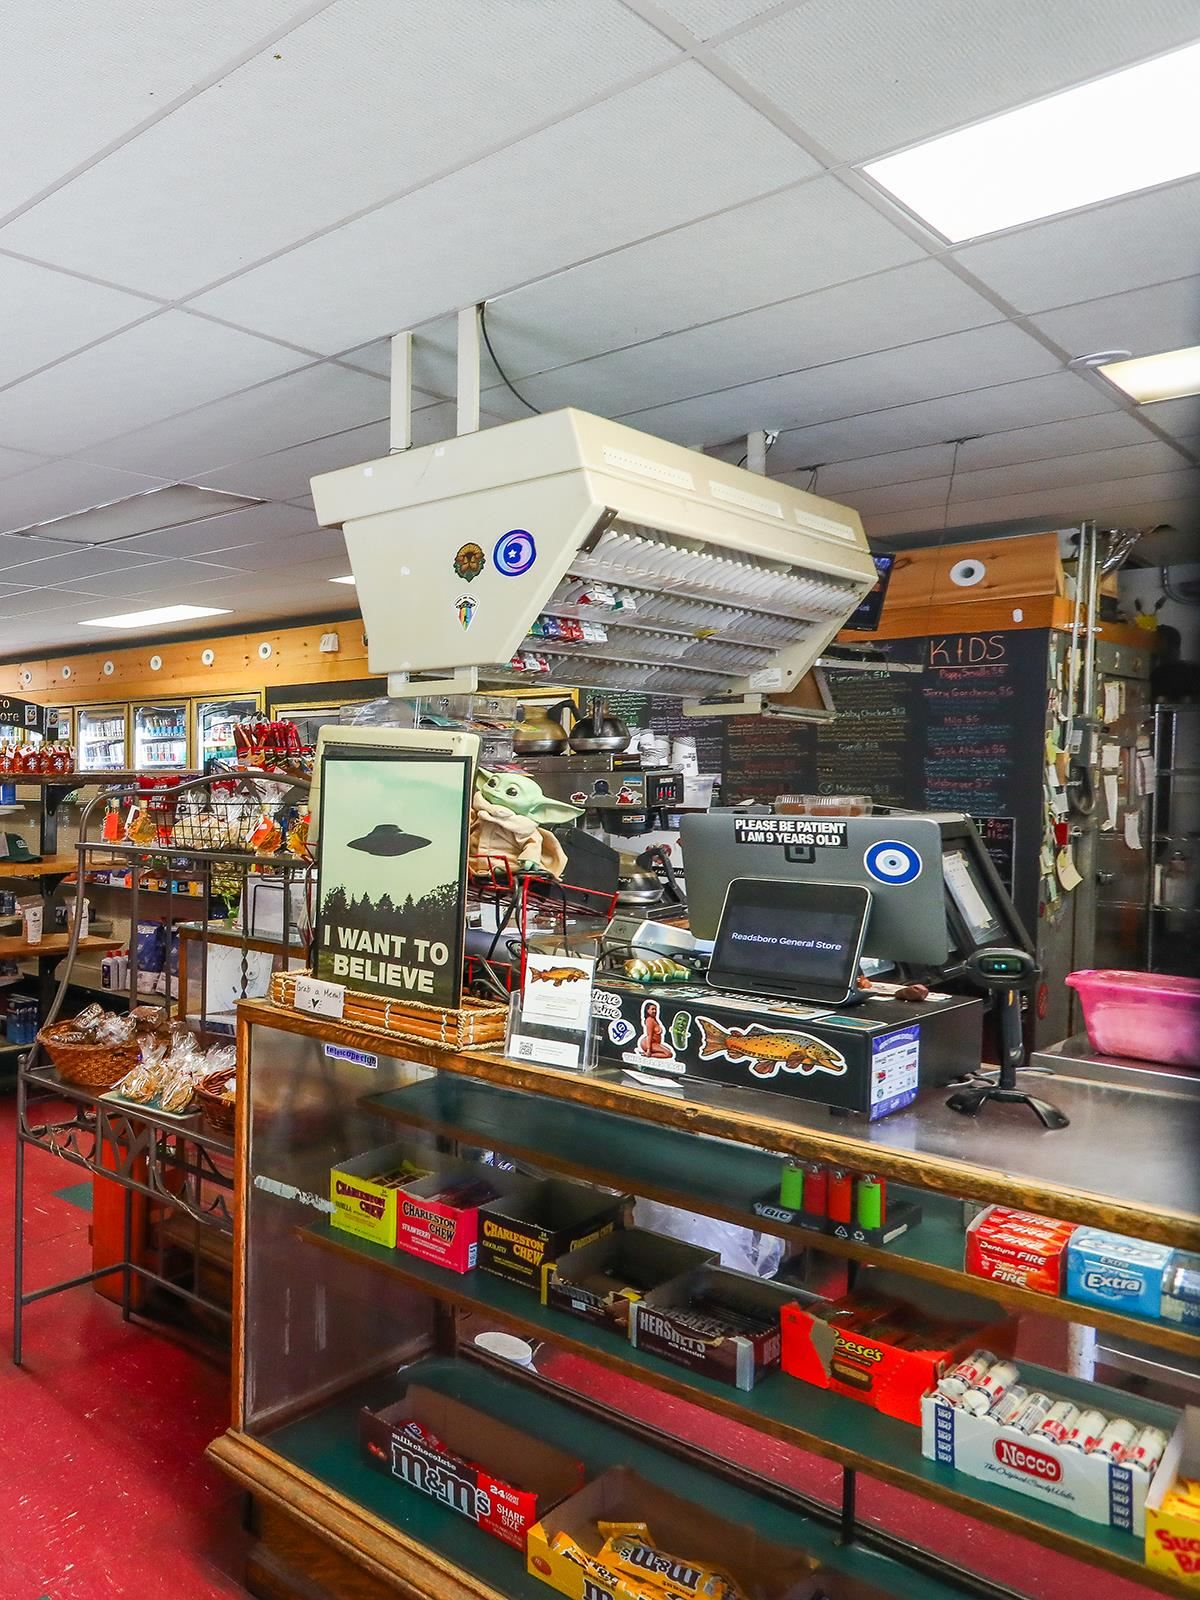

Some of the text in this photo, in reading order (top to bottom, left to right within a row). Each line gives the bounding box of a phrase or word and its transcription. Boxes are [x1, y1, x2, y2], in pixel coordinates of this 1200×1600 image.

[930, 635, 1006, 665] KIDS
[735, 819, 846, 834] PLEASE BE PATIENT
[741, 831, 841, 846] I AM 9 YEARS OLD
[323, 924, 449, 966] I WANT TO
[731, 932, 842, 952] Readsboro General Store
[333, 953, 435, 994] BELIEVE
[296, 981, 312, 992] Grab
[326, 1045, 360, 1061] telescope
[336, 1180, 386, 1207] CHARLESTON
[360, 1200, 385, 1220] CHEW
[402, 1201, 456, 1228] CHARLESTON
[763, 1205, 792, 1221] BIC
[401, 1222, 431, 1240] STRAWBERRY
[428, 1222, 456, 1242] CHEW
[483, 1219, 545, 1252] CHARLESTON
[512, 1244, 544, 1267] CHEW
[980, 1240, 1048, 1266] Dentyne FIRE
[991, 1269, 1028, 1287] FIRE
[1086, 1272, 1141, 1292] Extra
[391, 1432, 457, 1471] milk chocolate
[1000, 1441, 1057, 1478] Necco
[489, 1484, 506, 1500] 24
[496, 1503, 526, 1526] SHARE
[502, 1515, 520, 1533] SIZE
